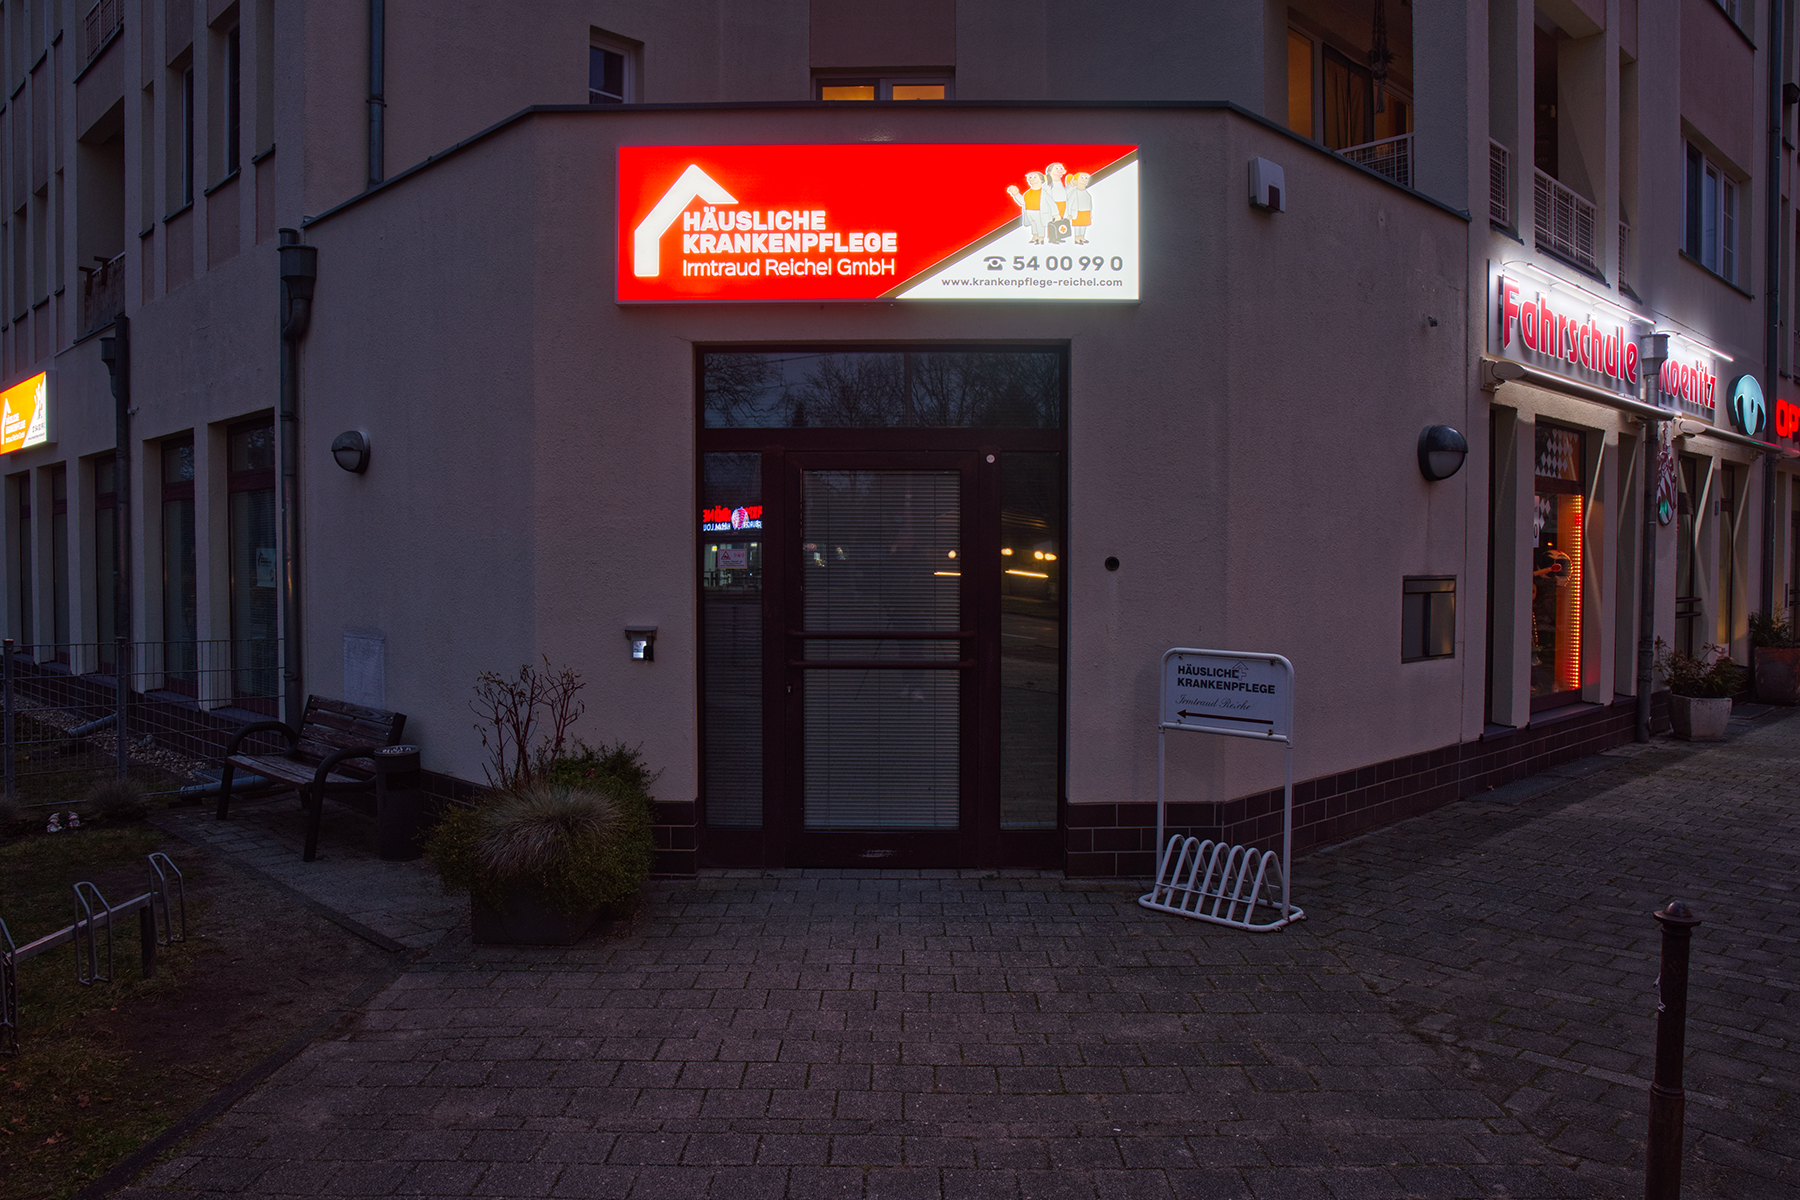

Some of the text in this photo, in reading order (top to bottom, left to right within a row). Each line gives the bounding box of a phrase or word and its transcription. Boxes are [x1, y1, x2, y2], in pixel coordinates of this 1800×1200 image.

[683, 206, 826, 231] HÄUSLICHE
[683, 232, 897, 253] KRANKENPFLEGE
[683, 257, 896, 277] Irmtraud Reichel GmbH
[1012, 255, 1124, 271] 54 00 99 0
[941, 276, 1123, 289] www.krankenpflege-reichel.com
[1502, 275, 1638, 385] Fahrschule
[1775, 398, 1800, 439] OP
[1178, 664, 1240, 679] HÄUSLICHE
[1177, 677, 1275, 694] KRANKENPFLEGE
[1175, 694, 1219, 707] Irmtraud
